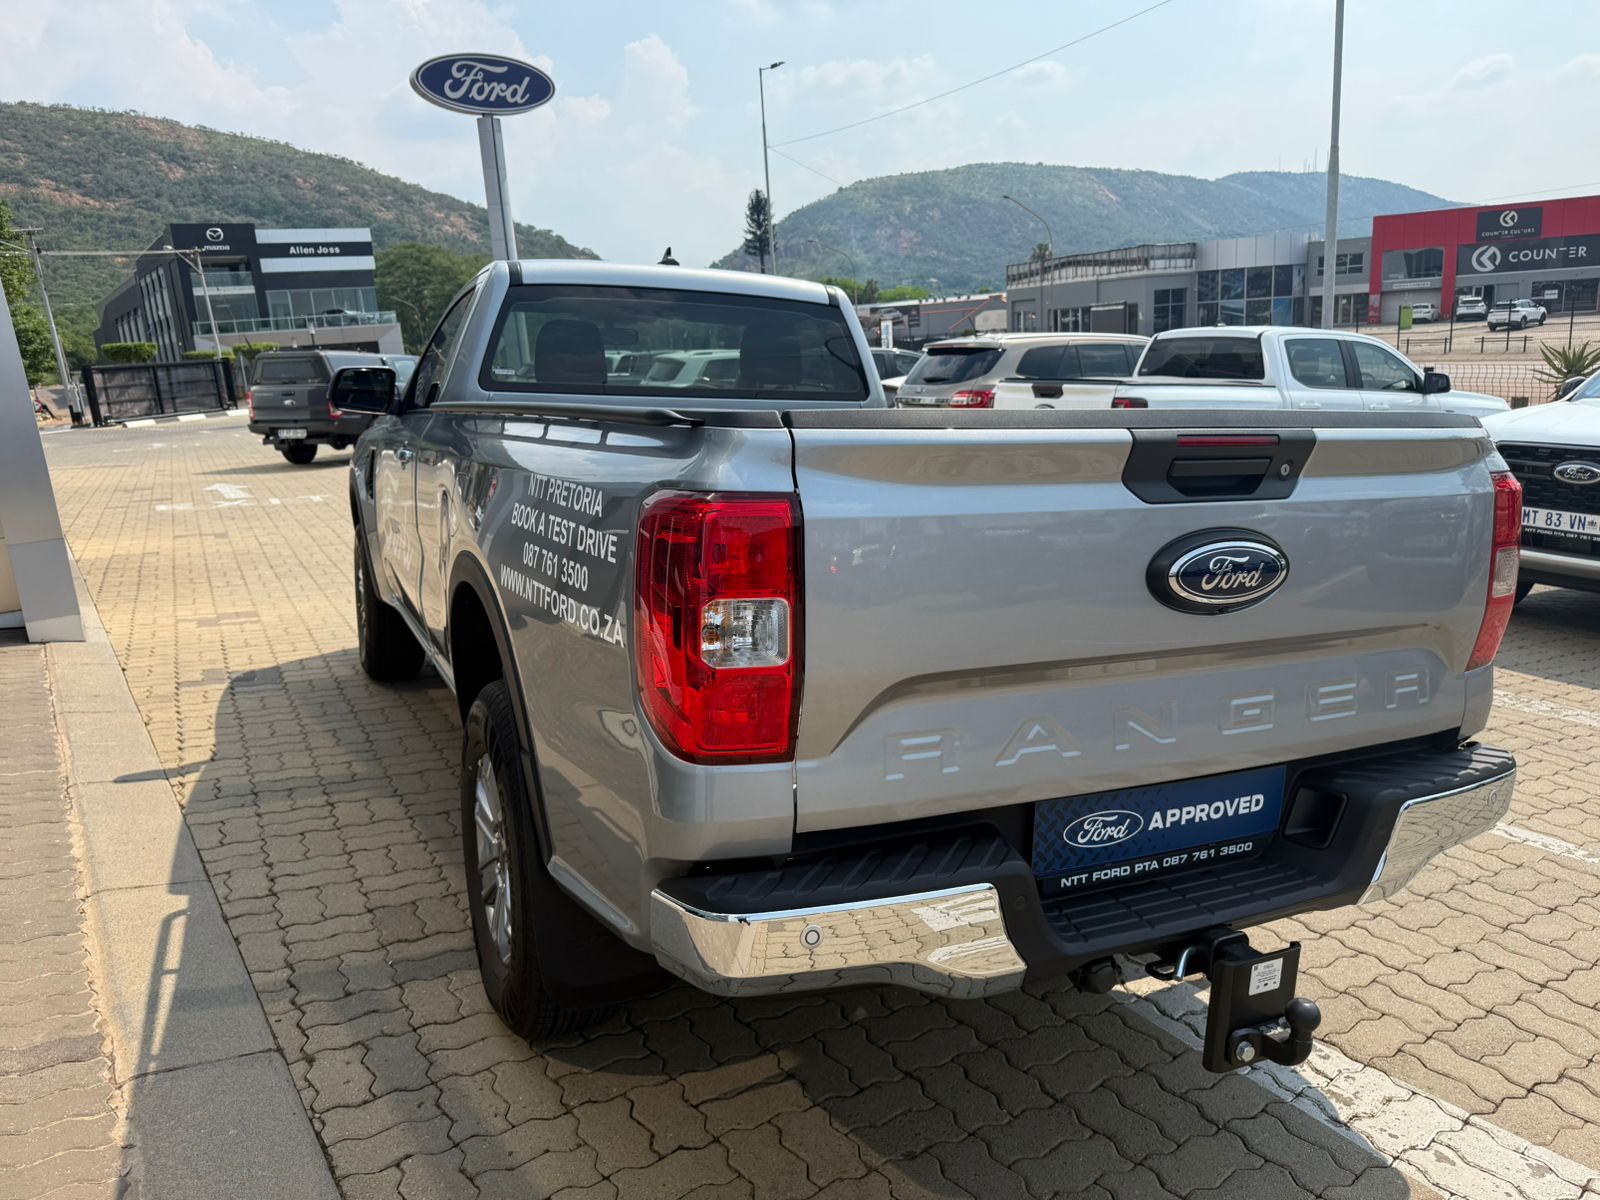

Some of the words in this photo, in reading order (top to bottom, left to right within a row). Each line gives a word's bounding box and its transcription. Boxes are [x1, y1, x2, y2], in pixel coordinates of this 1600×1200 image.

[443, 60, 530, 104] Ford
[290, 246, 315, 255] Allen
[317, 246, 341, 254] Joss
[1508, 246, 1588, 263] COUNTER
[528, 473, 548, 499] NTT
[546, 478, 603, 518] PRETORIA
[1564, 466, 1591, 480] Ford
[511, 502, 539, 533] BOOK
[536, 512, 545, 537] A
[547, 515, 576, 547] TEST
[576, 525, 618, 564] DRIVE
[1545, 512, 1562, 528] 83
[1569, 514, 1587, 532] VN
[523, 542, 539, 569] 087
[541, 548, 558, 579] 761
[561, 558, 588, 592] 3500
[1200, 554, 1263, 591] Ford
[500, 563, 625, 648] WWW.NTTFORD.CO.ZA
[884, 665, 1431, 782] RANGER
[1077, 816, 1130, 845] Ford
[1148, 794, 1264, 831] APPROVED
[1060, 874, 1088, 888] NTT
[1092, 865, 1130, 882] FORD
[1134, 861, 1159, 874] PTA
[1162, 854, 1188, 867] 087
[1192, 849, 1216, 862] 761
[1219, 842, 1253, 856] 3500
